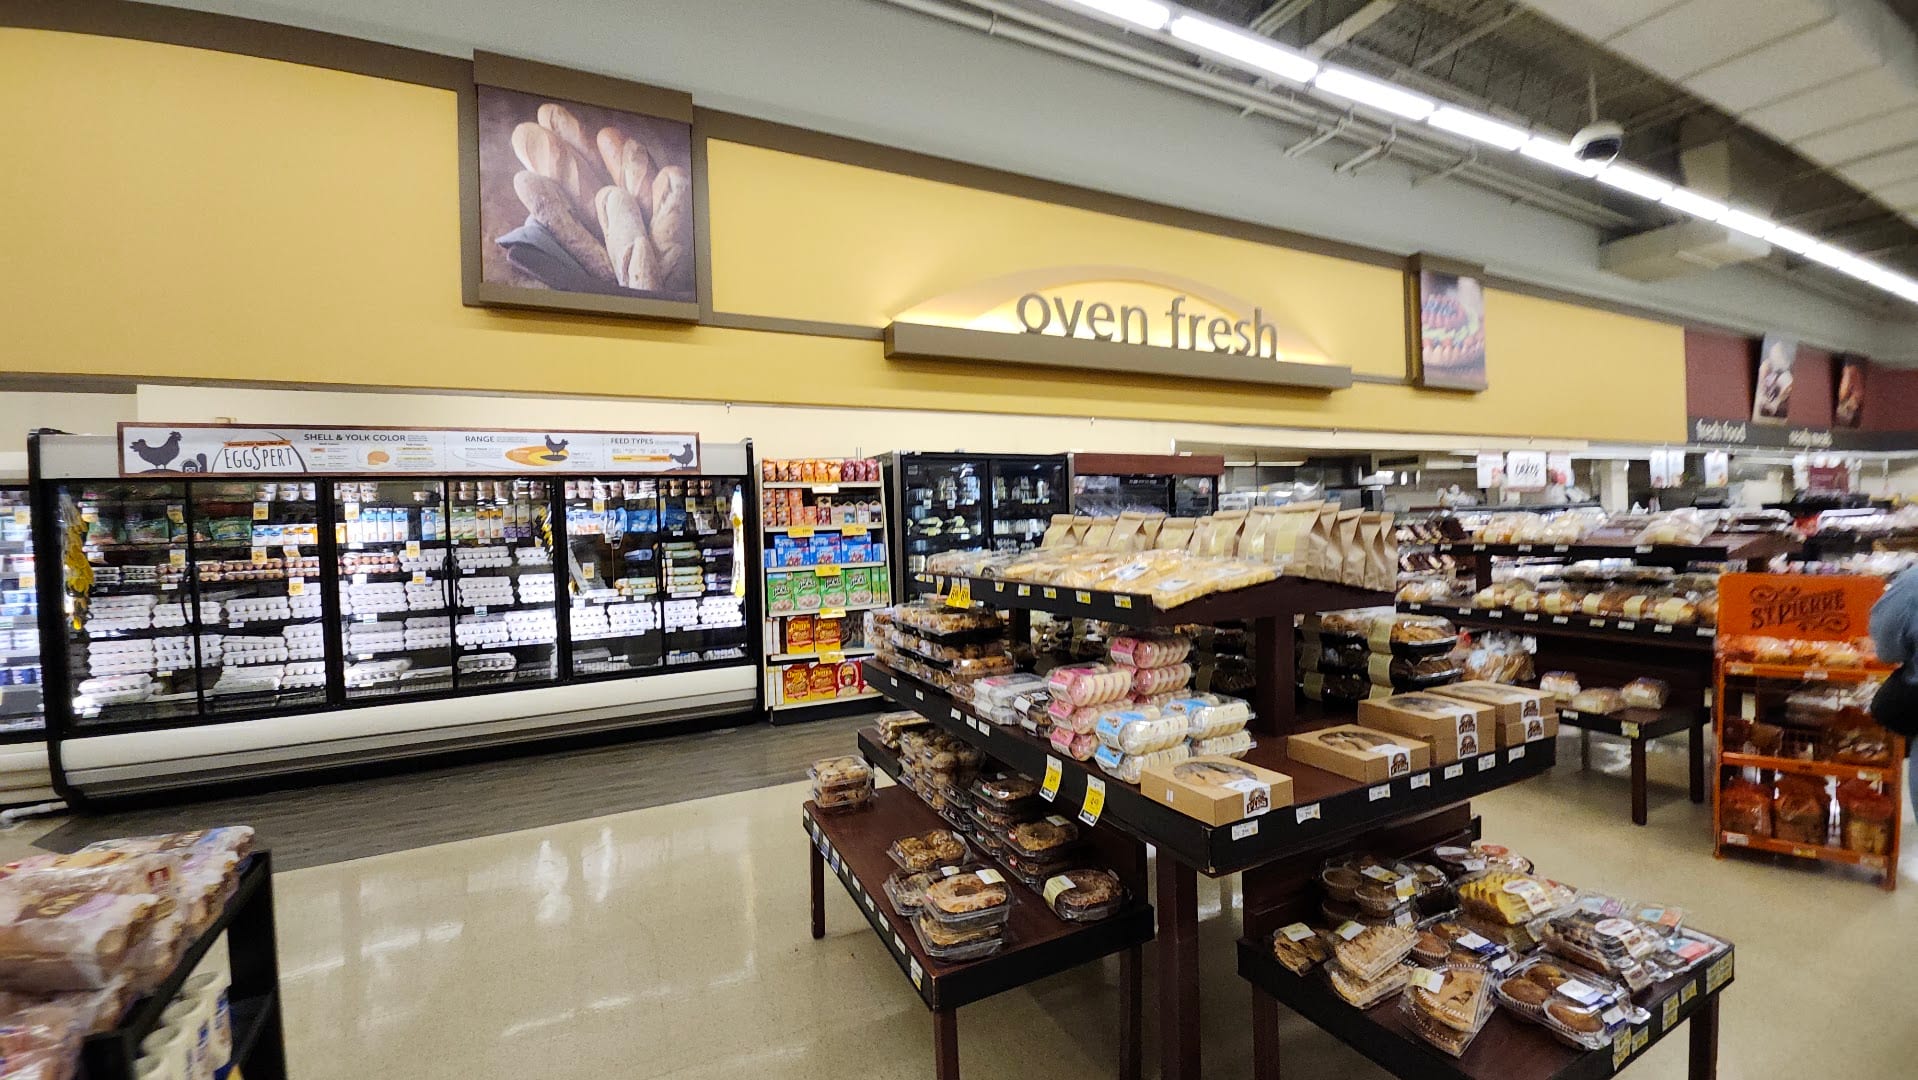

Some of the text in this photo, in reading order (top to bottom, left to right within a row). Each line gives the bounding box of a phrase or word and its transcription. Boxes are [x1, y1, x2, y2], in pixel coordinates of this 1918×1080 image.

[1016, 292, 1279, 362] oven fresh
[304, 433, 334, 441] SHELL
[372, 434, 406, 442] COLOR
[465, 435, 495, 443] RANGE
[224, 446, 292, 470] EGGSPERT
[1777, 588, 1845, 625] PIERRE
